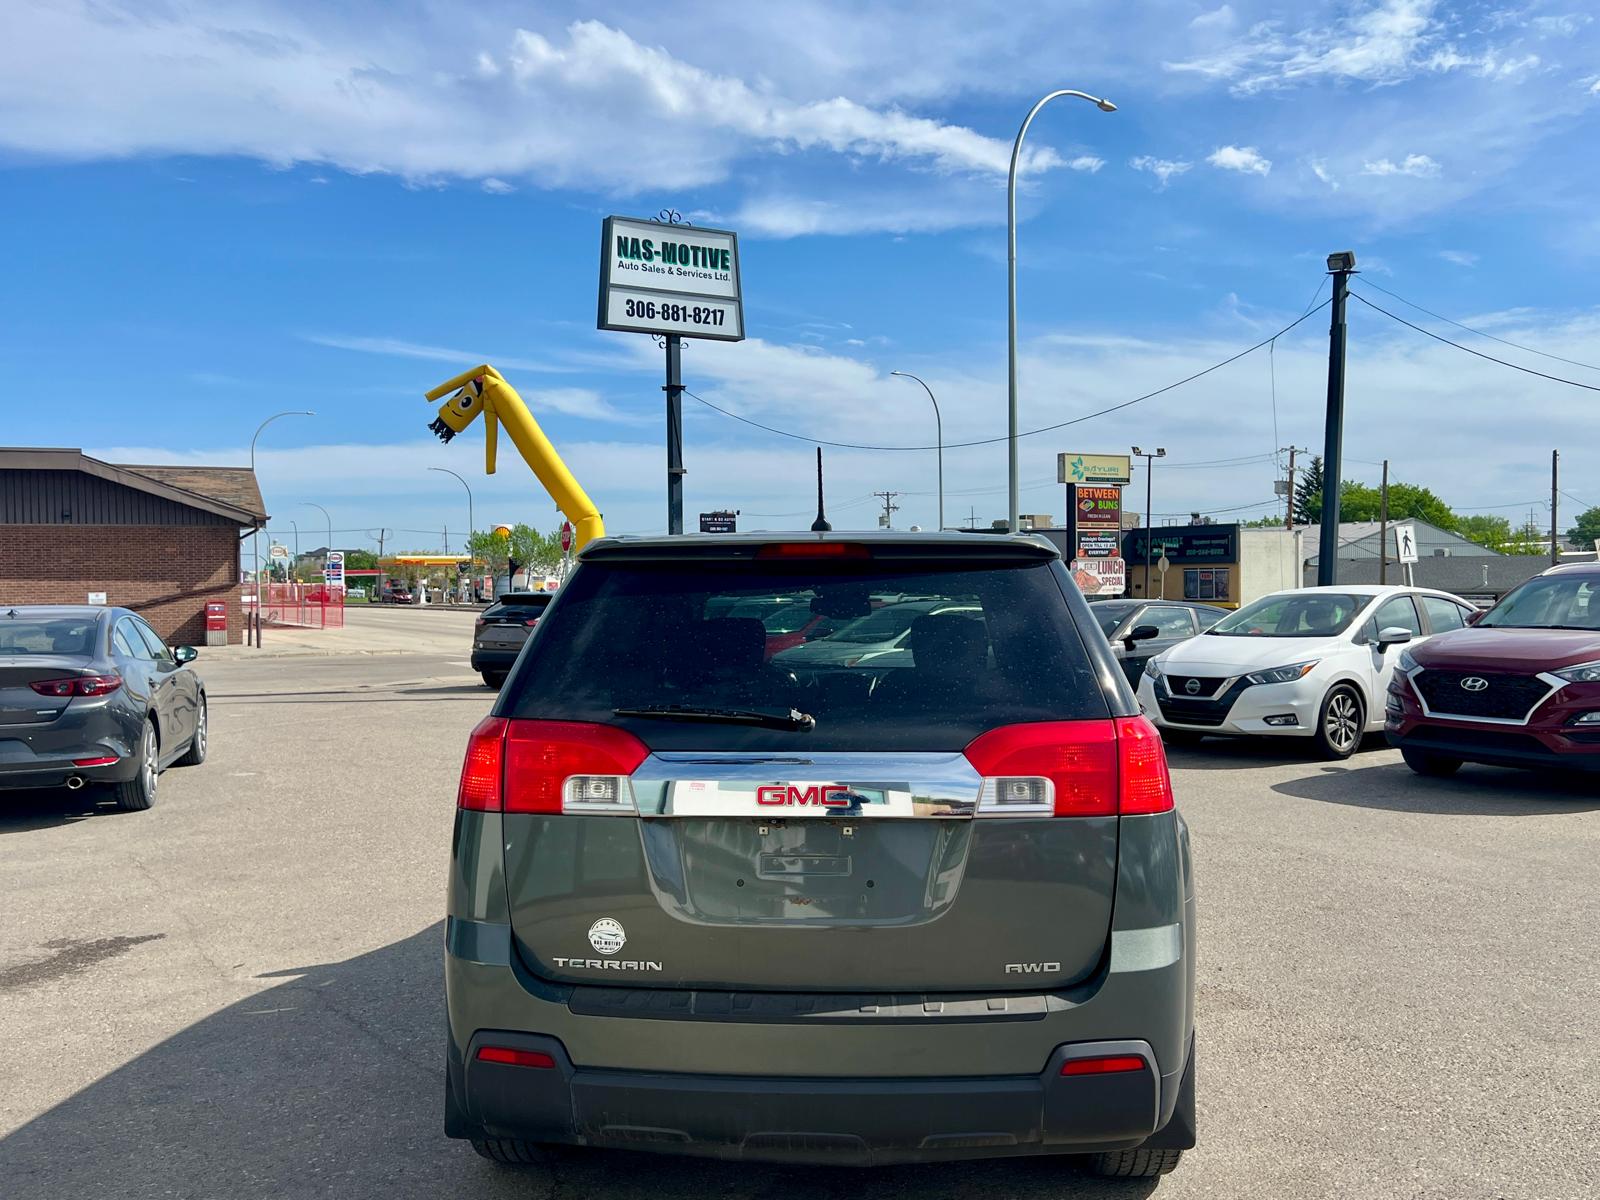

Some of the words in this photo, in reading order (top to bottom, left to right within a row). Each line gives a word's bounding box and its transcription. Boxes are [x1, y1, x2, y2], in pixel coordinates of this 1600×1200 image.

[617, 235, 731, 271] NAS-MOTIVE
[617, 260, 639, 271] Auto
[641, 263, 666, 275] Sales
[667, 266, 674, 275] &
[676, 267, 713, 280] Services
[714, 273, 731, 282] Ltd.
[625, 298, 725, 326] 306-881-8217
[1078, 488, 1119, 499] BETWEEN
[1097, 500, 1119, 510] BUNS
[1097, 560, 1124, 575] LUNCH
[1101, 576, 1124, 587] SPECIAL
[756, 785, 850, 807] GMC
[552, 957, 663, 971] TERRAIN
[1005, 962, 1061, 974] AWD
